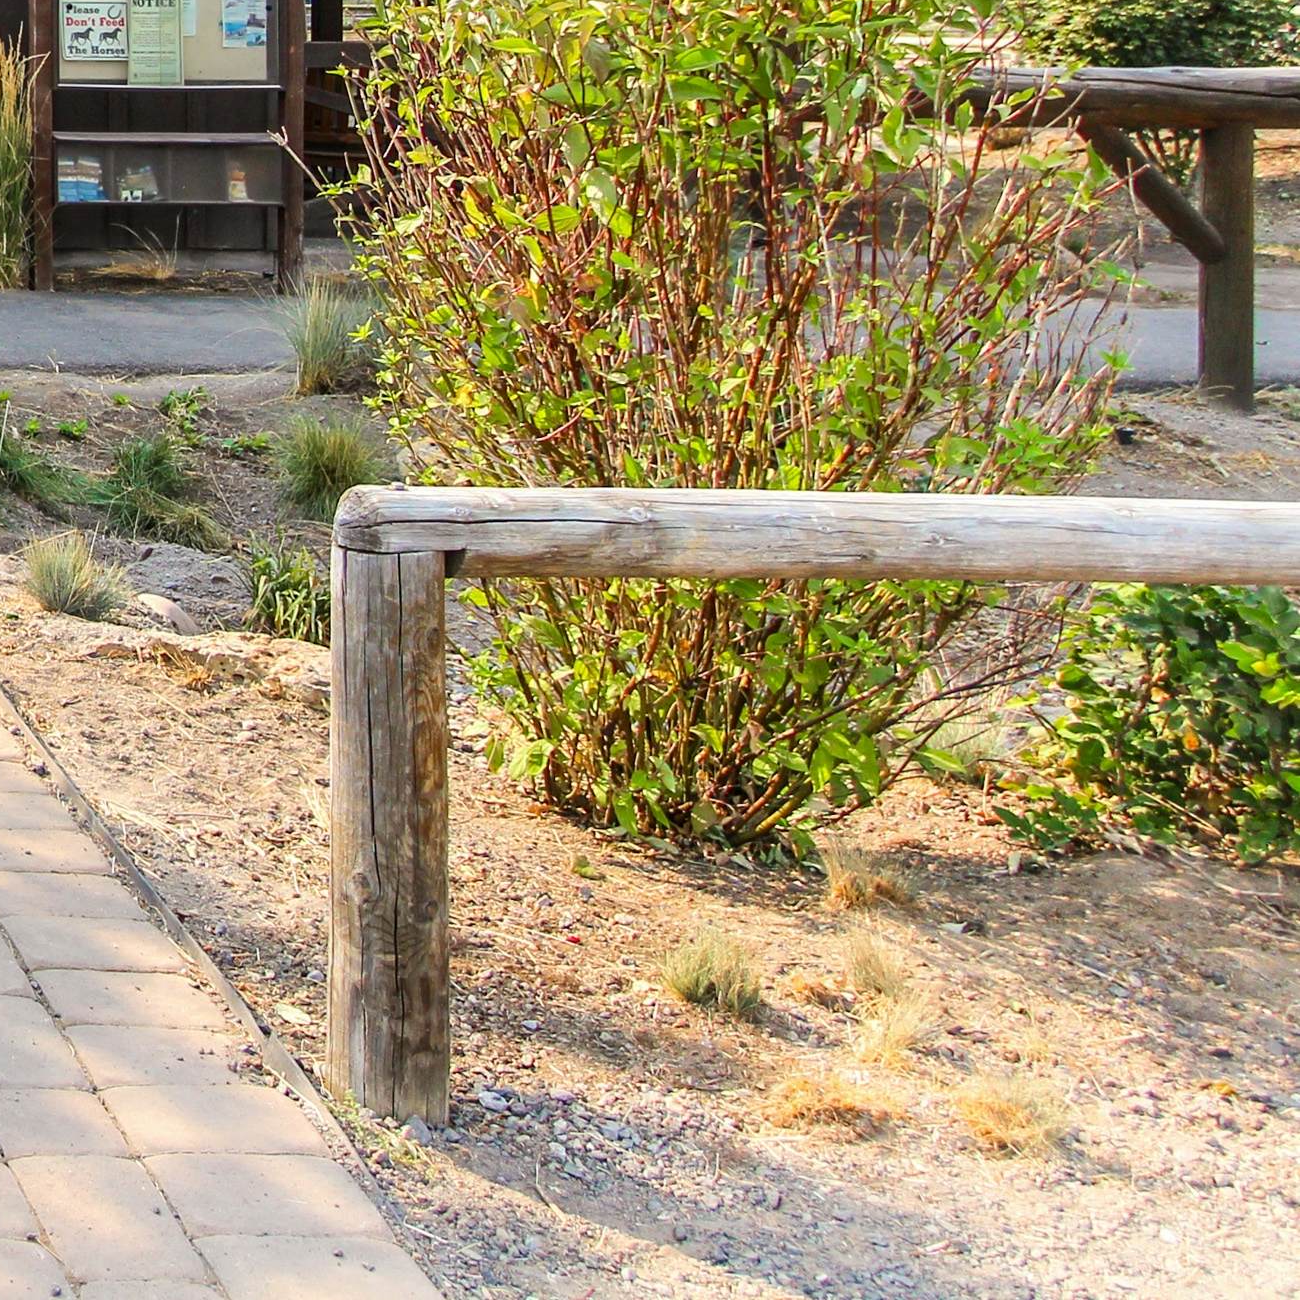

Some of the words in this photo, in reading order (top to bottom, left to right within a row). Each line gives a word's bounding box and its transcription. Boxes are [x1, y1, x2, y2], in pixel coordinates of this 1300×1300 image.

[66, 17, 95, 26] Don't
[99, 17, 125, 26] Feed
[67, 46, 87, 54] The
[91, 46, 125, 54] Horses
